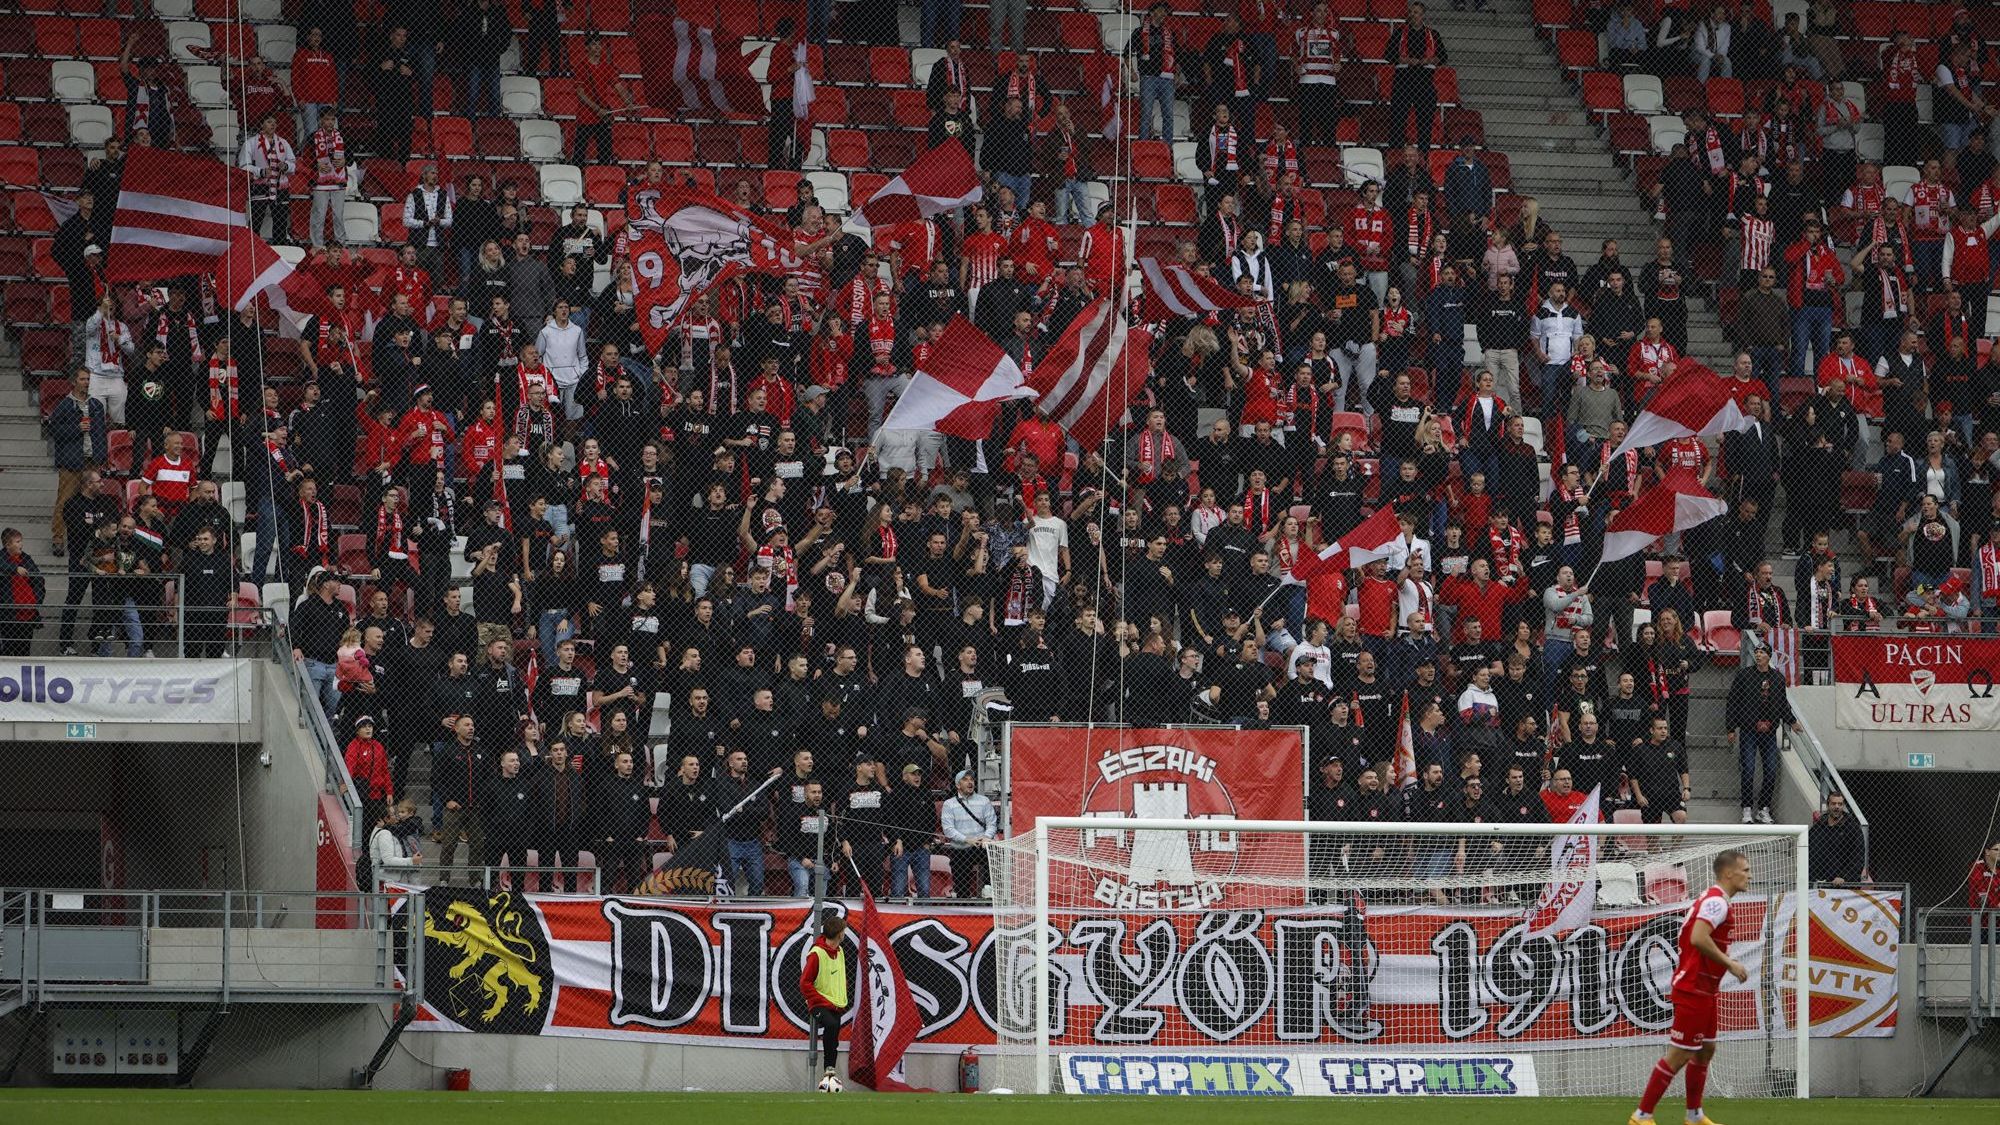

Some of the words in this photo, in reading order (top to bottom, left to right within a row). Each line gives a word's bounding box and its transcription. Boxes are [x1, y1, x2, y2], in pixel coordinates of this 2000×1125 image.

[79, 677, 219, 704] TYRES
[1871, 703, 1971, 723] ULTRAS
[1829, 898, 1889, 946] 1910
